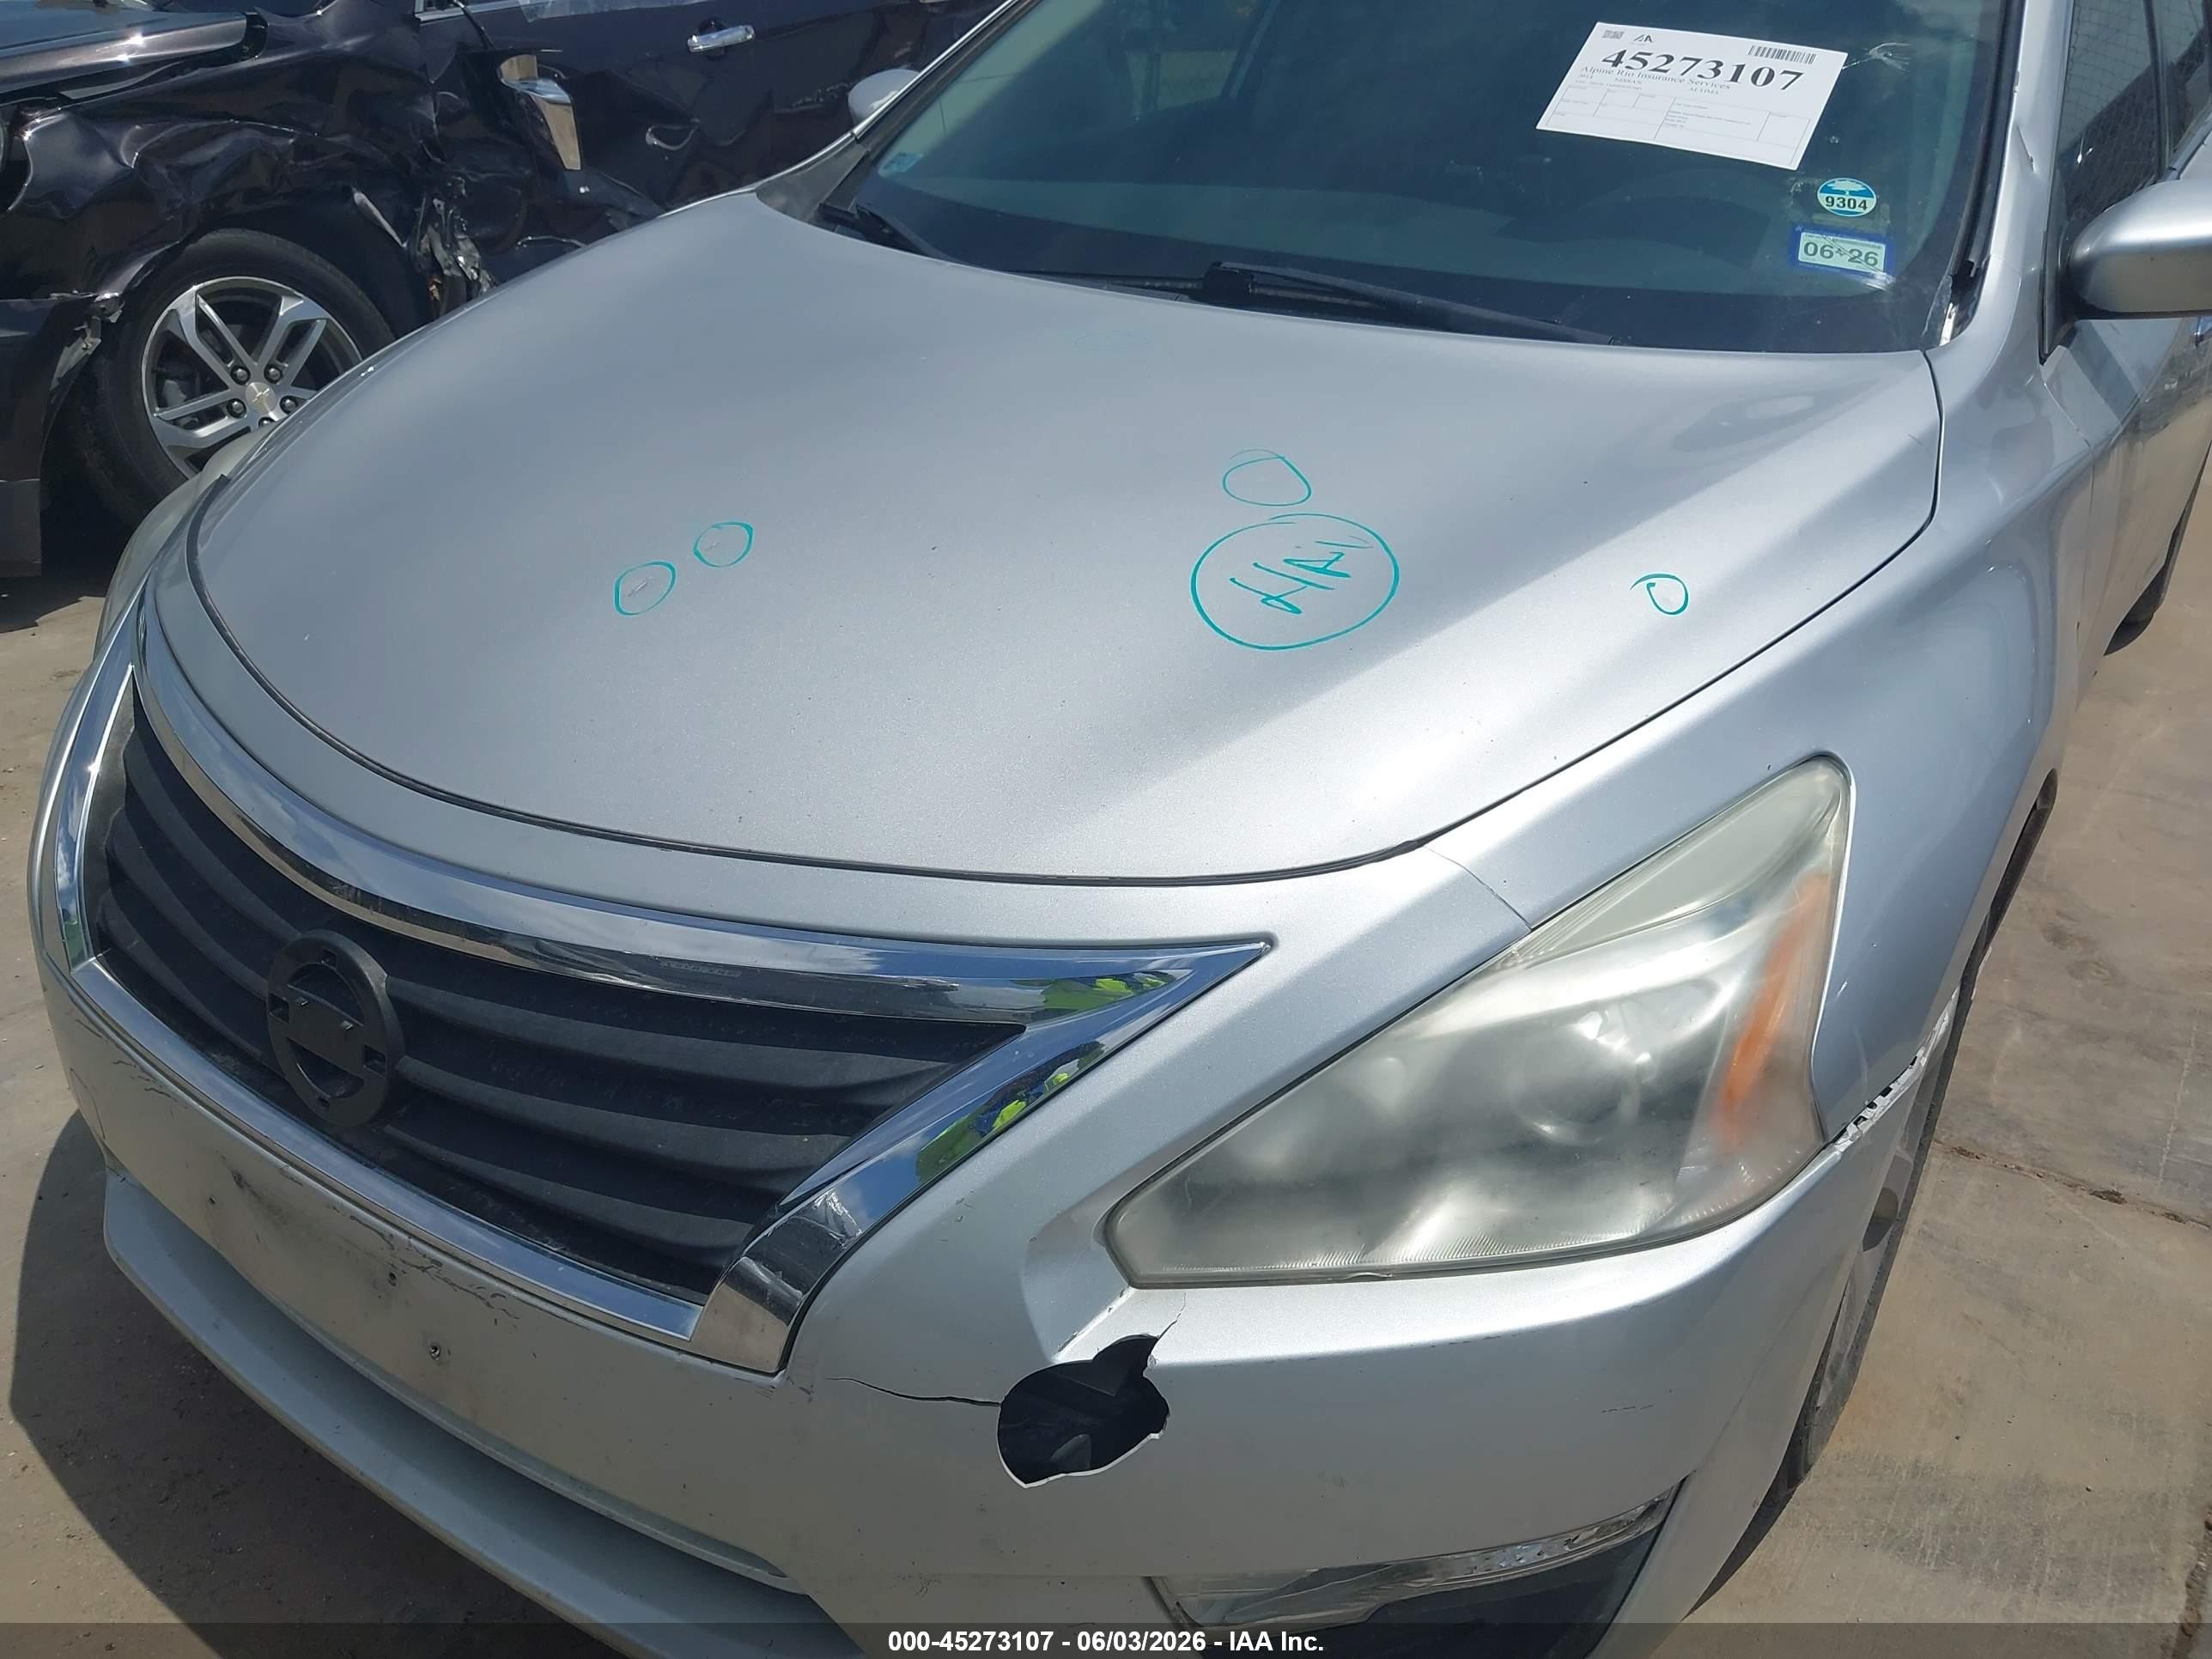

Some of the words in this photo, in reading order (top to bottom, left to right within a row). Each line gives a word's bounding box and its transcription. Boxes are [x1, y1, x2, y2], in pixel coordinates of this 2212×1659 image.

[1580, 66, 1614, 76] Alpine
[1637, 72, 1685, 83] Insurance
[1687, 78, 1731, 90] Services
[1601, 49, 1804, 91] 45273107
[1825, 196, 1869, 211] 9304
[1803, 241, 1834, 259] 06
[1847, 248, 1879, 266] 26
